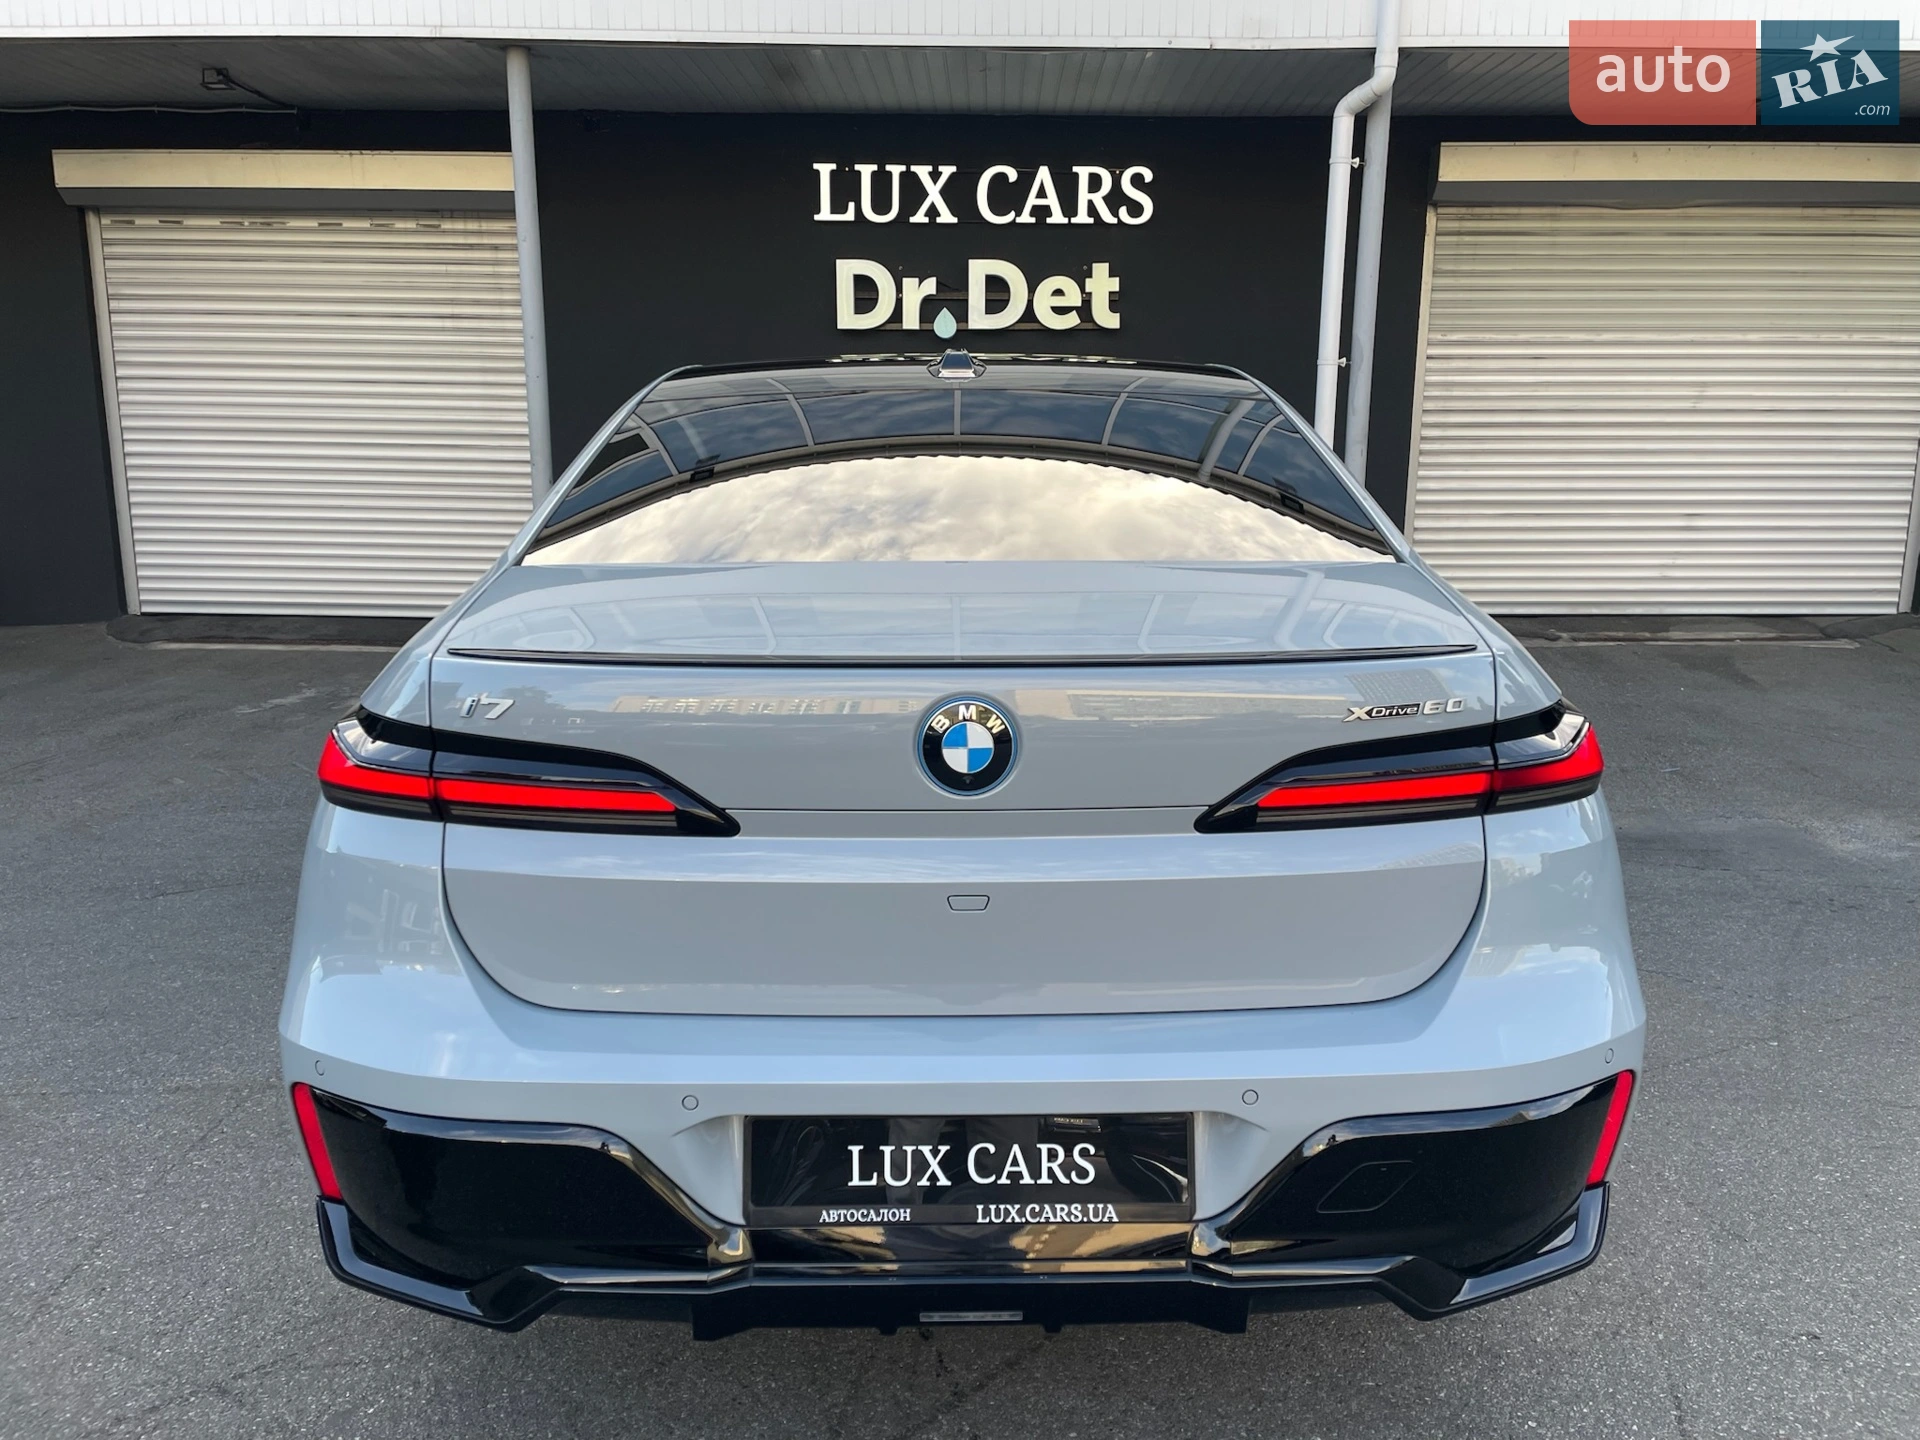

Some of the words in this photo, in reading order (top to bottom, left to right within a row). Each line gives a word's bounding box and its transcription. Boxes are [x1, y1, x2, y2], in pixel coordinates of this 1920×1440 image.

[813, 163, 958, 224] LUX
[976, 165, 1154, 225] CARS
[460, 694, 515, 720] i7
[931, 704, 1006, 734] BMW
[847, 1145, 952, 1187] LUX
[967, 1143, 1096, 1185] CARS
[819, 1207, 911, 1223] АВТОСАЛОН
[976, 1203, 1119, 1223] LUX.CARS.UA
